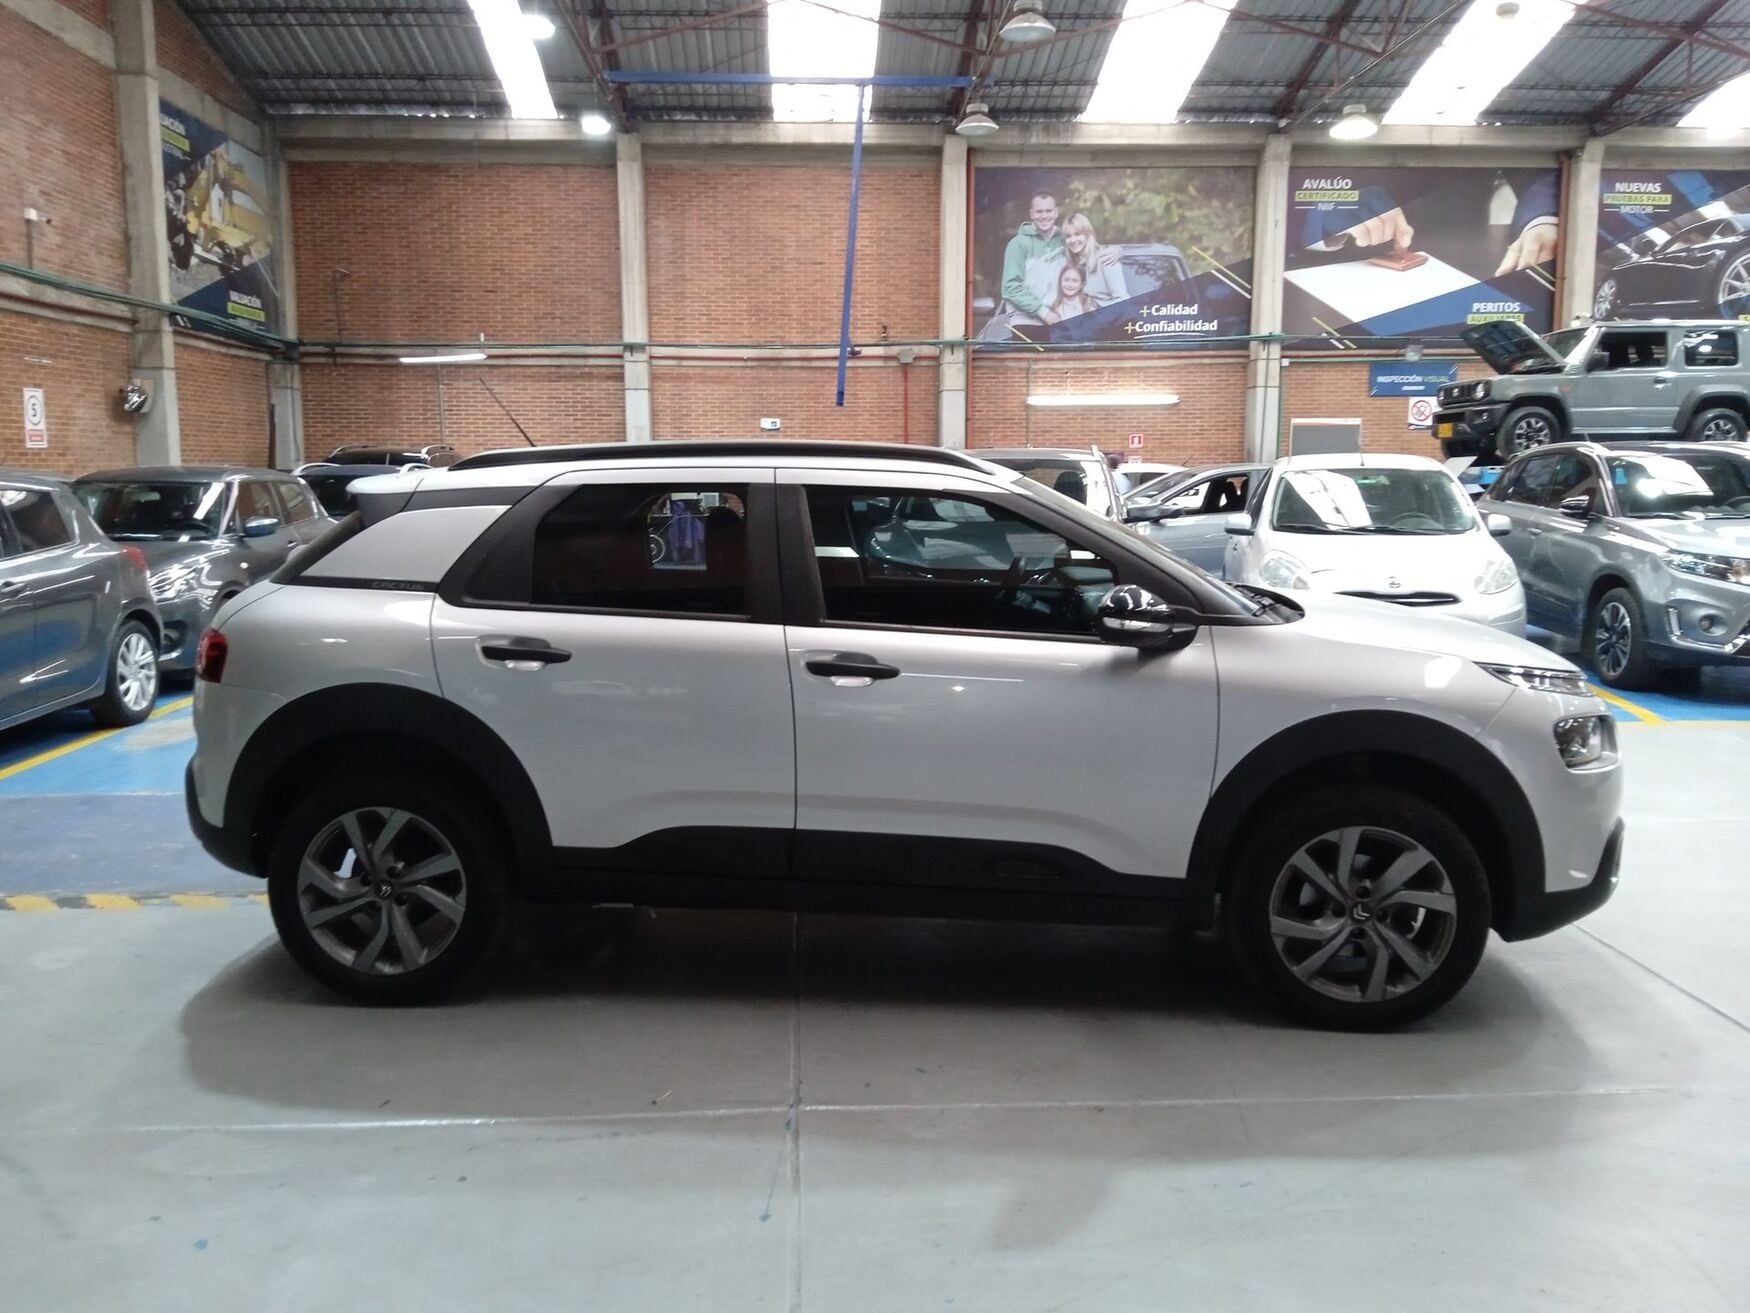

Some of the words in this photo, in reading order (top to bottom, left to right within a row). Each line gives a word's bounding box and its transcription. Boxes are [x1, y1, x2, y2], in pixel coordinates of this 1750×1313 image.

[1302, 176, 1353, 190] AVALÚO
[1615, 182, 1662, 193] NUEVAS
[1296, 192, 1356, 200] CERTIFICADO
[1647, 195, 1669, 203] PARA
[1620, 205, 1655, 214] MOTOR
[1472, 302, 1521, 313] PERITOS
